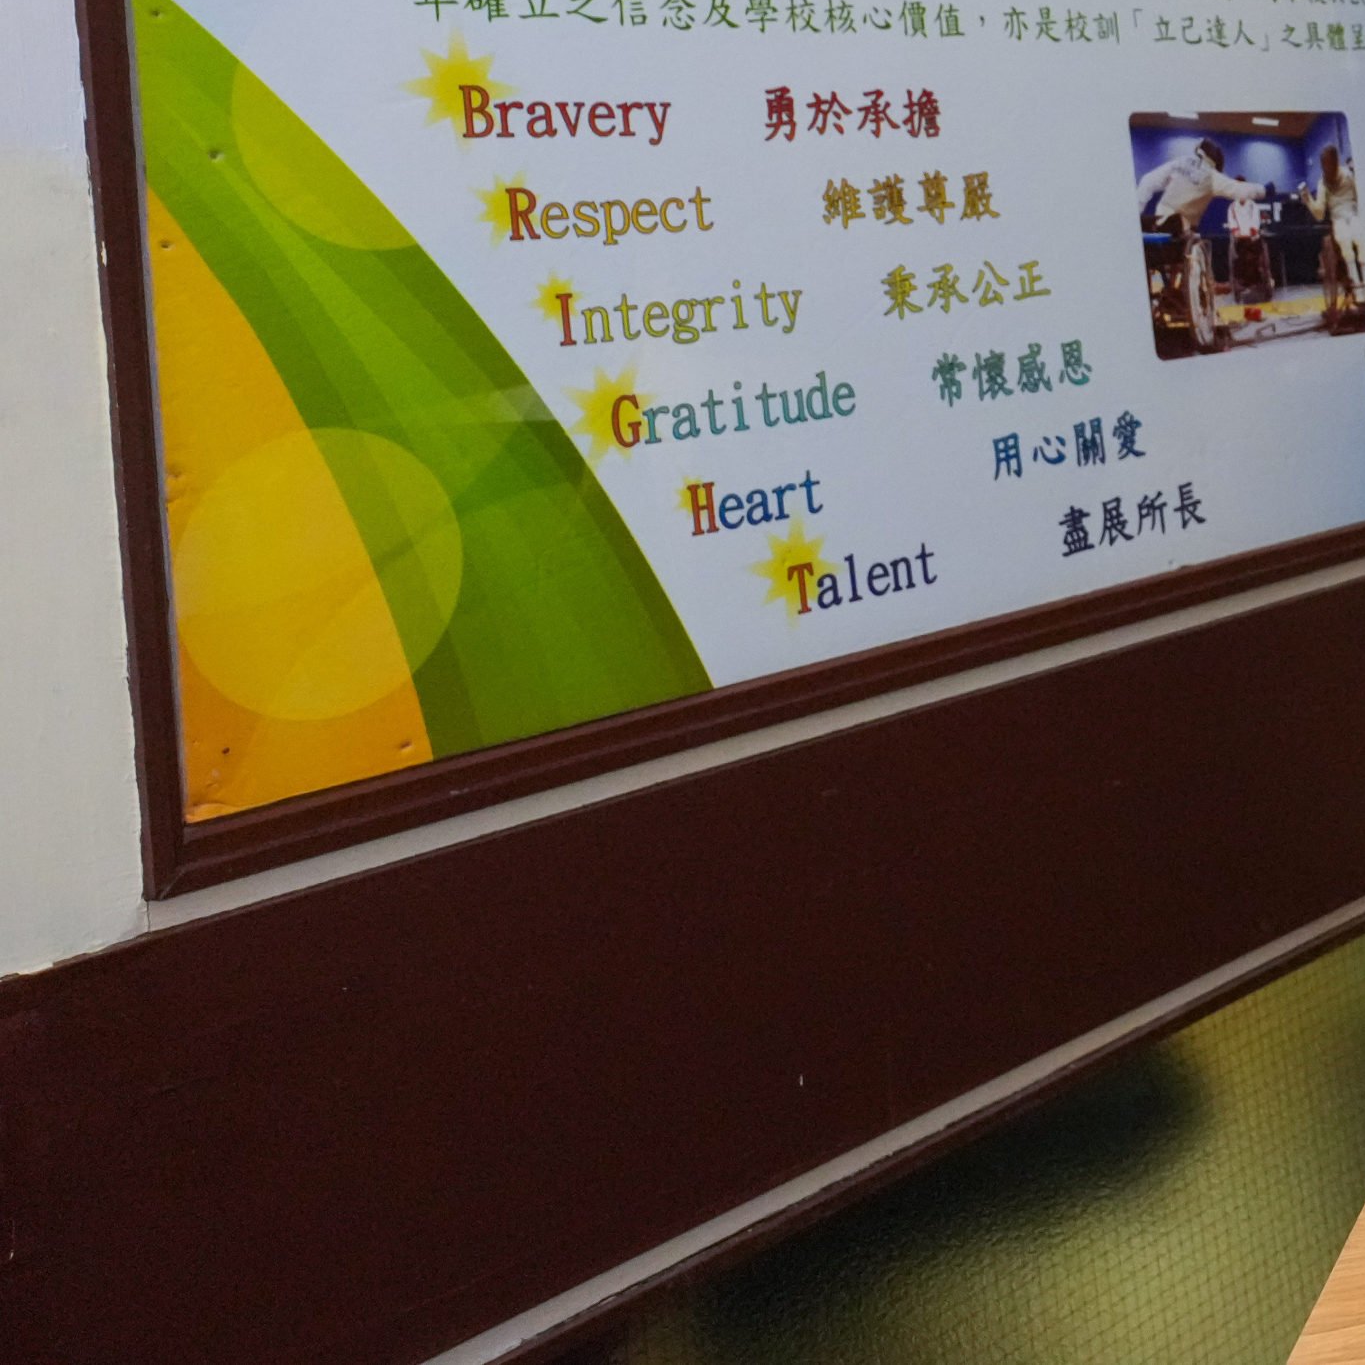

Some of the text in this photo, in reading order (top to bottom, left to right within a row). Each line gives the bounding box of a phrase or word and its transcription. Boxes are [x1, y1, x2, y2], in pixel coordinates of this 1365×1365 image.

[458, 83, 672, 146] Bravery
[763, 85, 942, 142] 勇於承擔
[504, 184, 715, 245] Respect
[821, 170, 1002, 229] 維護尊嚴
[555, 279, 804, 347] Integrity
[880, 260, 1053, 321] 秉承公正
[931, 339, 1094, 408] 常懷感恩
[611, 369, 857, 449] Gratitude
[991, 409, 1147, 482] 用心關愛
[686, 469, 824, 536] Heart
[1058, 480, 1207, 557] 盡展所長
[787, 541, 939, 616] Talent
